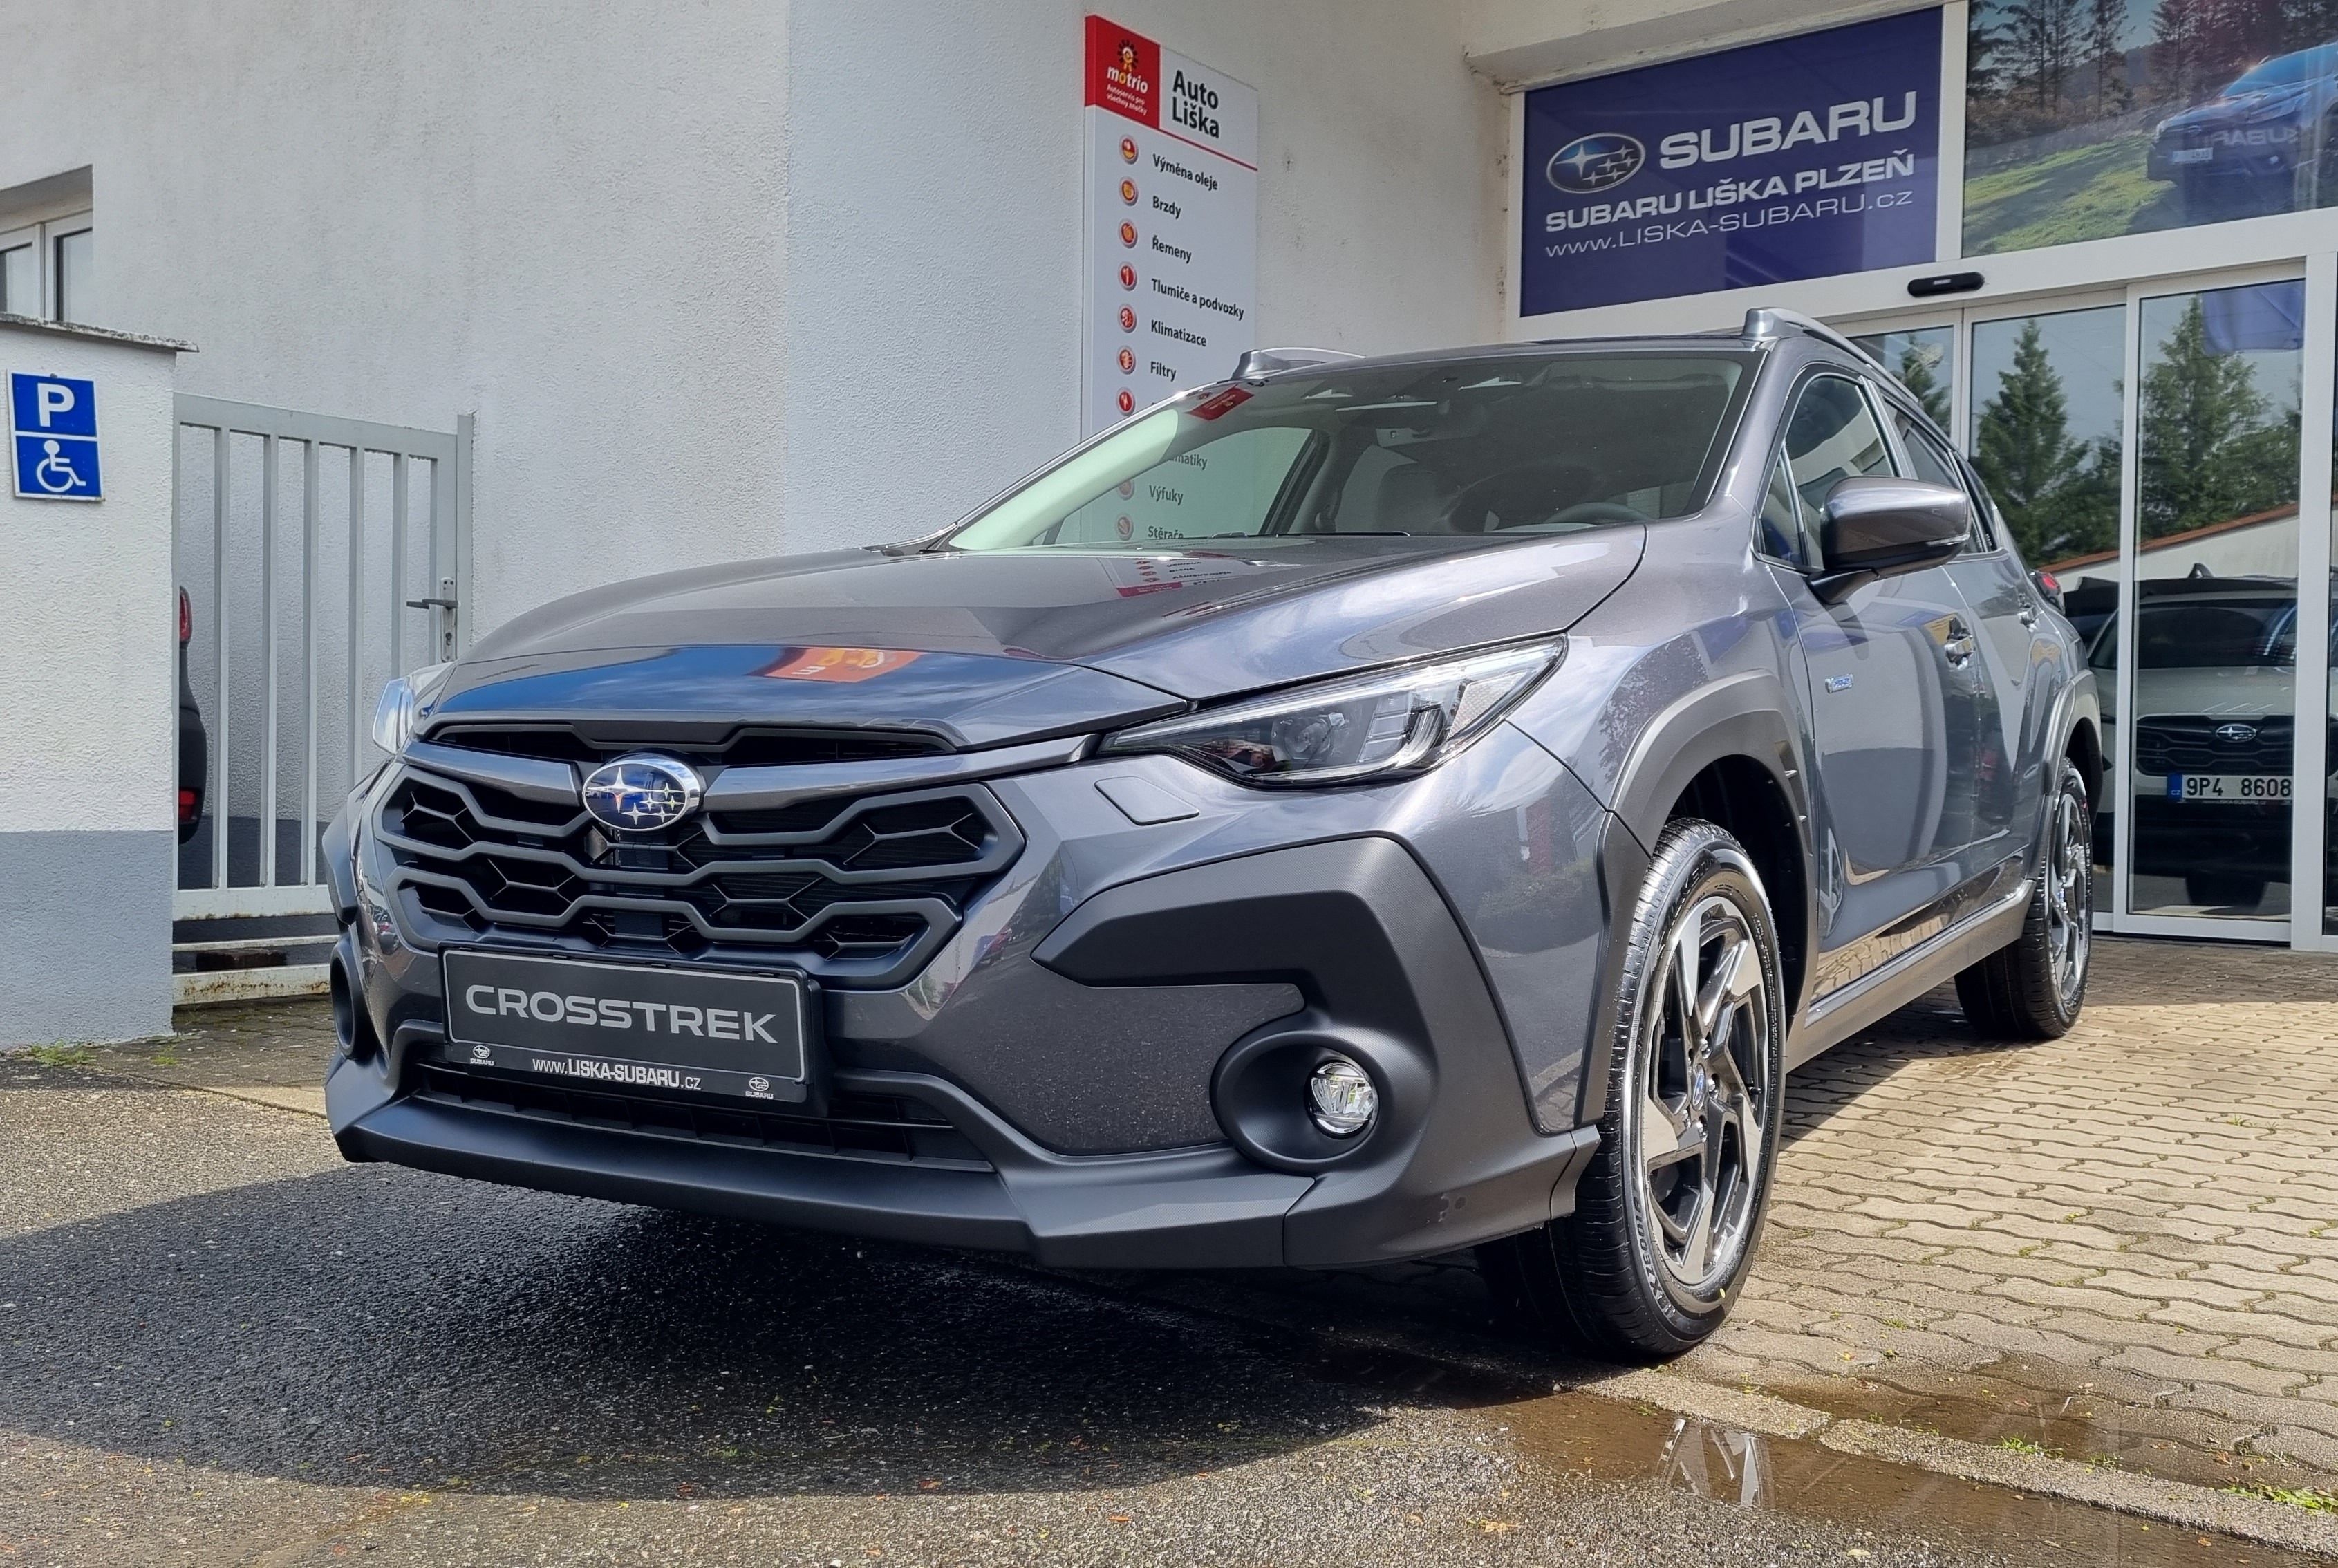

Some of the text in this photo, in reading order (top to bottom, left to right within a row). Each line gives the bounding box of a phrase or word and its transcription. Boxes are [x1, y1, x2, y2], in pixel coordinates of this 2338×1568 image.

[1107, 66, 1148, 93] motrio
[1172, 70, 1218, 109] Auto
[1172, 97, 1219, 138] Liška
[1659, 91, 1917, 170] SUBARU
[1152, 153, 1218, 191] Výměna oleje
[1546, 149, 1914, 232] SUBARU LIŠKA PLZEŇ
[1152, 196, 1181, 219] Brzdy
[1546, 190, 1914, 258] www.LISKA-SUBARU.cz
[1152, 234, 1192, 264] Řemeny
[1151, 278, 1244, 321] Tlumiče a podvozky
[1151, 319, 1206, 347] Klimatizace
[1150, 361, 1177, 382] Filtry
[37, 382, 75, 427] P
[1174, 454, 1208, 470] matiky
[1149, 485, 1183, 505] Výfuky
[2187, 778, 2224, 796] 9P4
[2241, 778, 2292, 797] 8608
[466, 984, 778, 1044] CROSSTREK
[470, 1058, 494, 1066] SUBARU
[745, 1090, 774, 1099] SUBARU
